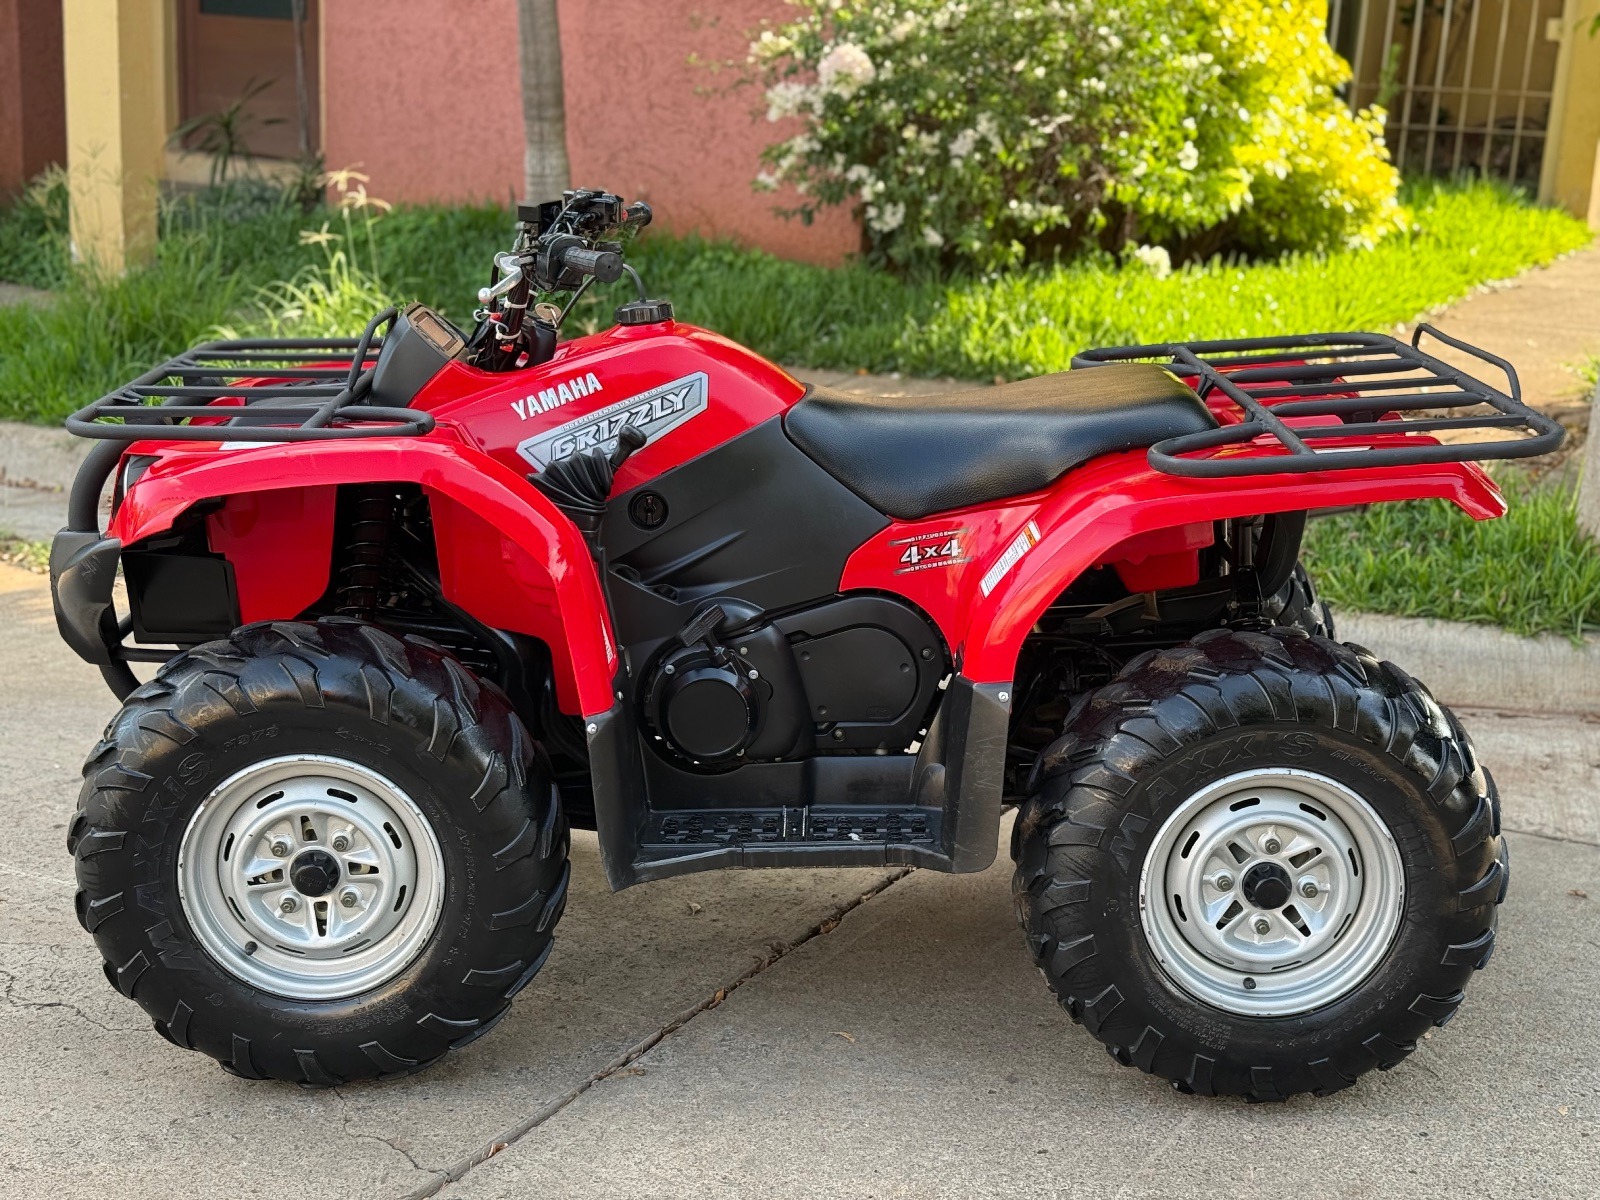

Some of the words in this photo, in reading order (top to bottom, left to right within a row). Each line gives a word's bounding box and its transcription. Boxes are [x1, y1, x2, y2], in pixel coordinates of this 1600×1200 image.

[510, 372, 604, 421] YAMAHA
[550, 384, 695, 461] GRIZZLY
[1109, 732, 1319, 874] MAXXIS
[133, 752, 212, 972] MAXXIS
